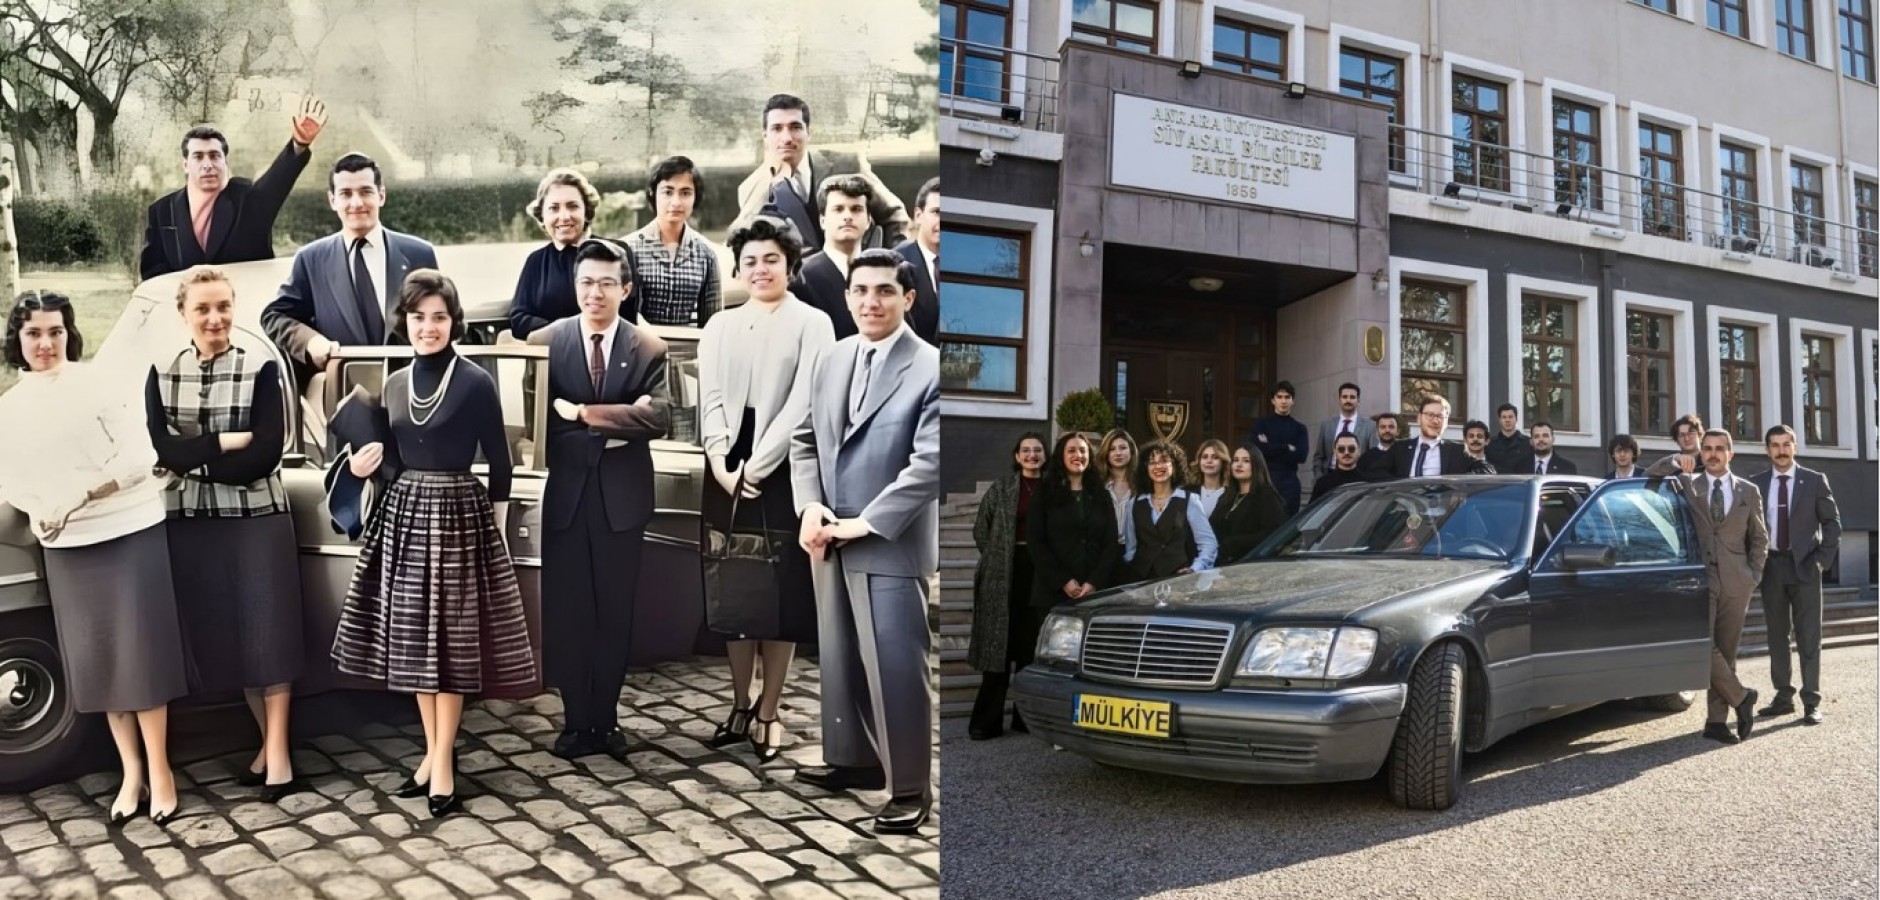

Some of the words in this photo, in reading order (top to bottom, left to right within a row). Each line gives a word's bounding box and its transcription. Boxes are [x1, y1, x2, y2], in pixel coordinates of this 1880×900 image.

[1151, 106, 1221, 131] ANKARA
[1224, 117, 1327, 150] ÜNİVERSİTESİ
[1153, 125, 1235, 156] SİYASAL
[1242, 140, 1322, 171] BİLGİLER
[1192, 155, 1290, 187] FAKÜLTESİ
[1080, 699, 1169, 732] MÜLKİYE
